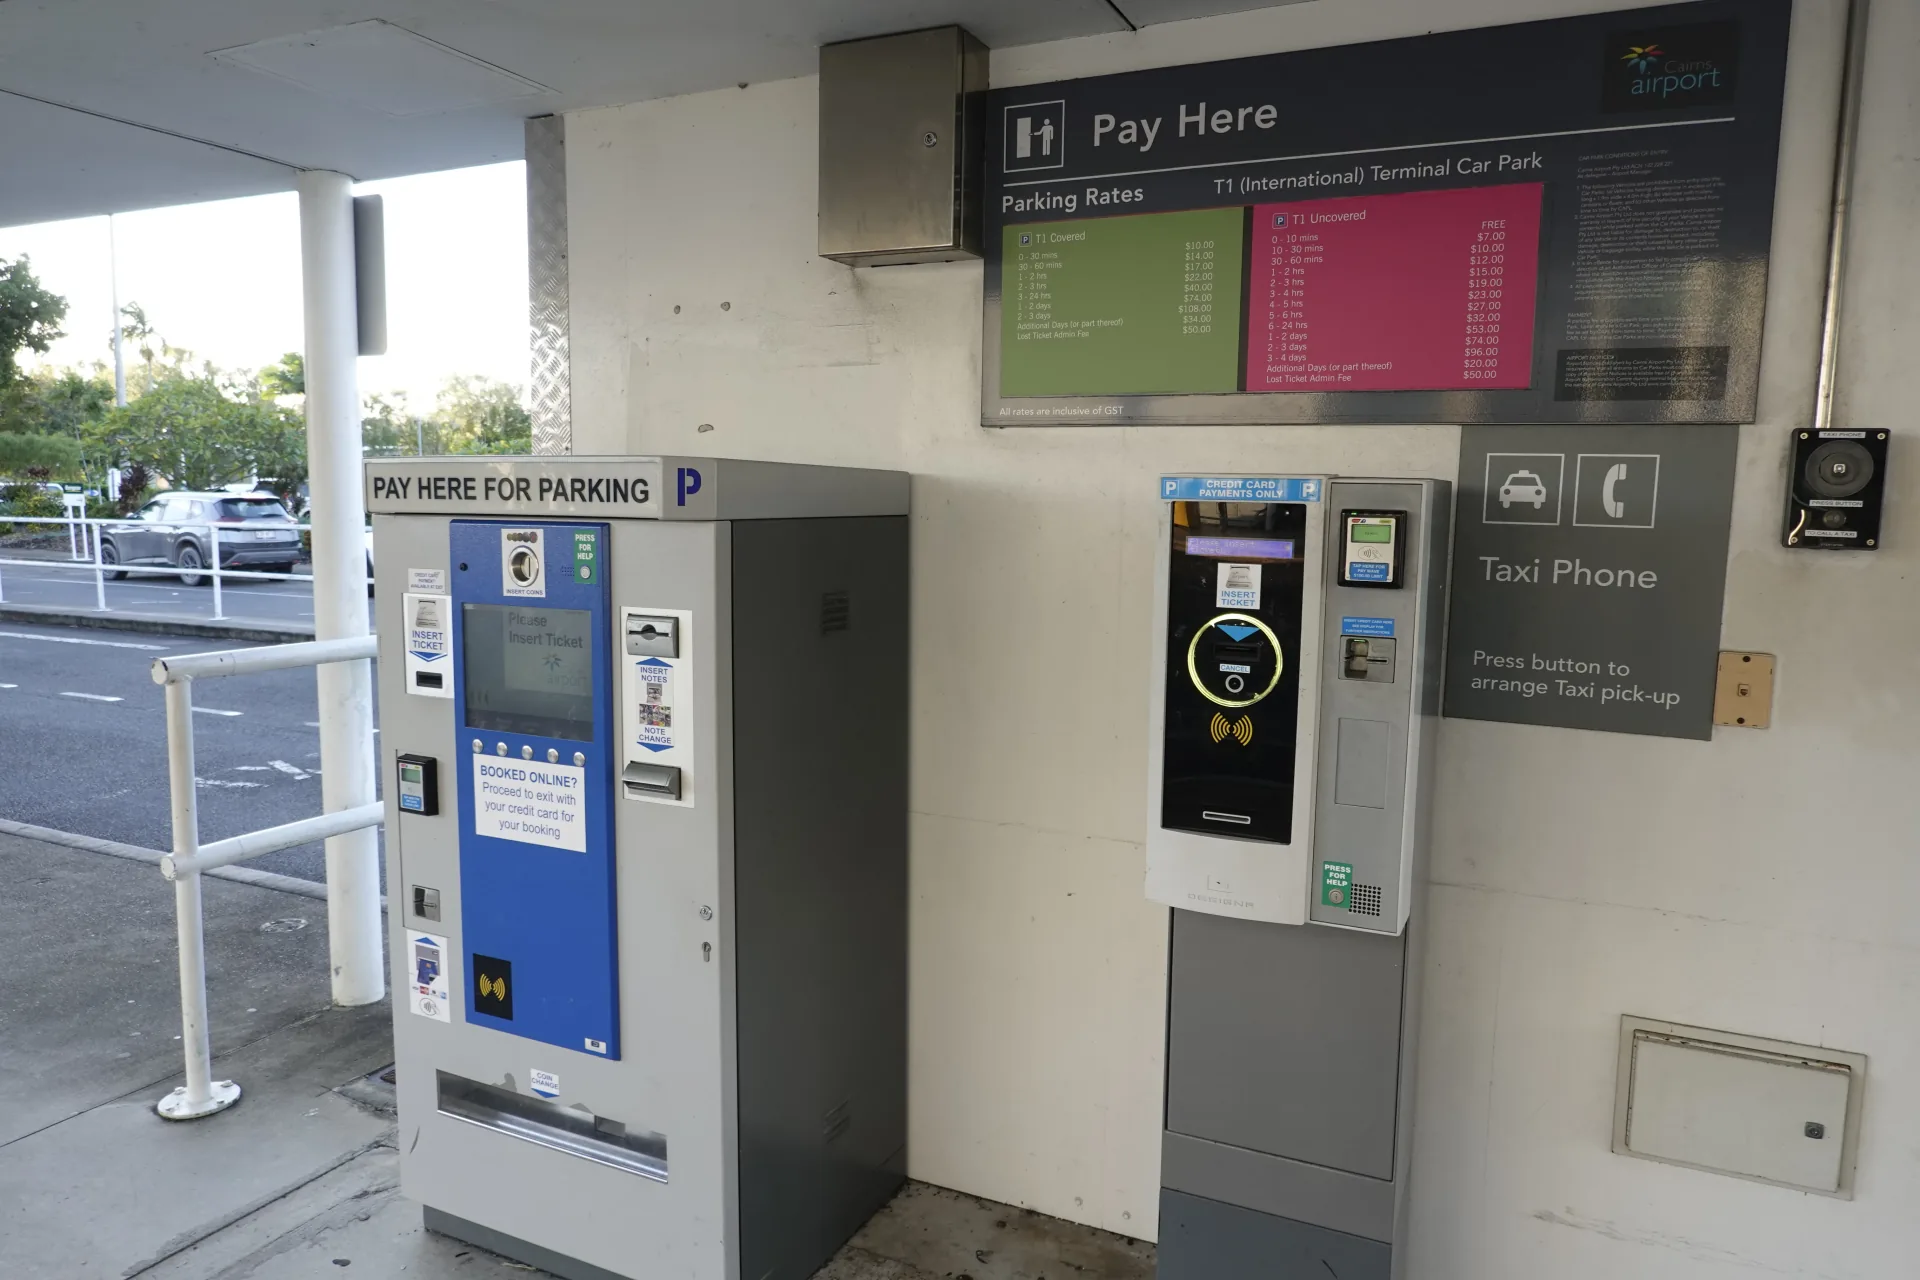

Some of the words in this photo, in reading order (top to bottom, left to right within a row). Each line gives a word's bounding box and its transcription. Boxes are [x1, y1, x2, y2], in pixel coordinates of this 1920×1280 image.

[1665, 61, 1712, 73] Cairns
[1632, 68, 1720, 98] airport
[1093, 108, 1161, 150] Pay
[1179, 100, 1278, 136] Here
[1214, 175, 1234, 194] T1
[1240, 165, 1364, 194] (International)
[1371, 157, 1451, 180] Terminal
[1456, 156, 1491, 175] Car
[1497, 152, 1543, 171] Park
[1002, 187, 1079, 215] Parking
[1085, 184, 1144, 207] Rates
[1293, 215, 1304, 224] T1
[1311, 210, 1366, 223] Uncovered
[1482, 220, 1506, 229] FREE
[1036, 234, 1046, 243] T1
[1051, 231, 1085, 242] Covered
[1478, 232, 1505, 241] $7.00
[1186, 241, 1214, 250] $10.00
[1471, 244, 1504, 253] $10.00
[1185, 252, 1213, 260] $14.00
[1470, 255, 1503, 265] $12.00
[1185, 262, 1213, 271] $17.00
[1470, 267, 1503, 276] $15.00
[1185, 273, 1212, 281] $22.00
[1184, 284, 1212, 292] $40.00
[1469, 279, 1502, 288] $19.00
[1184, 294, 1212, 302] $74.00
[1468, 290, 1501, 299] $23.00
[1178, 304, 1211, 314] $108.00
[1468, 302, 1500, 311] $27.00
[1183, 315, 1211, 323] $34.00
[1467, 313, 1500, 322] $32.00
[1017, 322, 1049, 330] Additional
[1052, 321, 1068, 329] Days
[1097, 318, 1123, 326] thereof)
[1183, 325, 1211, 333] $50.00
[1466, 325, 1499, 334] $53.00
[1033, 331, 1051, 339] Ticket
[1466, 336, 1499, 345] $74.00
[1465, 348, 1498, 357] $96.00
[1267, 364, 1304, 372] Additional
[1308, 364, 1326, 373] Days
[1330, 363, 1340, 371] (or
[1343, 363, 1358, 372] part
[1362, 362, 1392, 370] thereof)
[1464, 359, 1497, 368] $20.00
[1464, 371, 1496, 379] $50.00
[1000, 408, 1010, 416] All
[1053, 406, 1089, 415] inclusive
[1093, 406, 1101, 414] of
[1104, 406, 1124, 414] GST
[678, 468, 701, 506] P
[1166, 481, 1176, 494] P
[1207, 481, 1243, 489] CREDIT
[1247, 481, 1275, 489] CARD
[374, 477, 411, 498] PAY
[418, 477, 476, 500] HERE
[485, 478, 531, 501] FOR
[539, 478, 649, 503] PARKING
[1256, 490, 1283, 498] ONLY
[1302, 483, 1315, 497] P
[575, 534, 595, 542] PRESS
[1479, 557, 1539, 583] Taxi
[1553, 559, 1657, 588] Phone
[1221, 591, 1255, 599] INSERT
[509, 612, 547, 627] Please
[412, 631, 443, 640] INSERT
[510, 631, 542, 645] Insert
[545, 633, 583, 648] Ticket
[413, 640, 443, 650] TICKET
[1474, 650, 1524, 669] Press
[1532, 654, 1600, 675] button
[1608, 660, 1630, 676] to
[641, 667, 668, 675] INSERT
[1221, 664, 1249, 672] CANCEL
[641, 675, 667, 683] NOTES
[1471, 675, 1548, 697] arrange
[1555, 680, 1594, 699] Taxi
[1601, 686, 1680, 710] pick-up
[645, 727, 665, 735] NOTE
[639, 735, 671, 744] CHANGE
[480, 765, 526, 781] BOOKED
[529, 771, 577, 788] ONLINE?
[483, 782, 521, 798] Proceed
[525, 788, 533, 799] to
[537, 788, 553, 802] exit
[556, 792, 576, 806] with
[485, 801, 505, 813] your
[508, 802, 534, 816] credit
[537, 805, 559, 819] card
[562, 808, 574, 822] for
[500, 820, 519, 832] your
[522, 820, 560, 840] booking
[1325, 864, 1350, 873] PRESS
[537, 1073, 552, 1081] COIN
[532, 1078, 559, 1089] CHANGE
